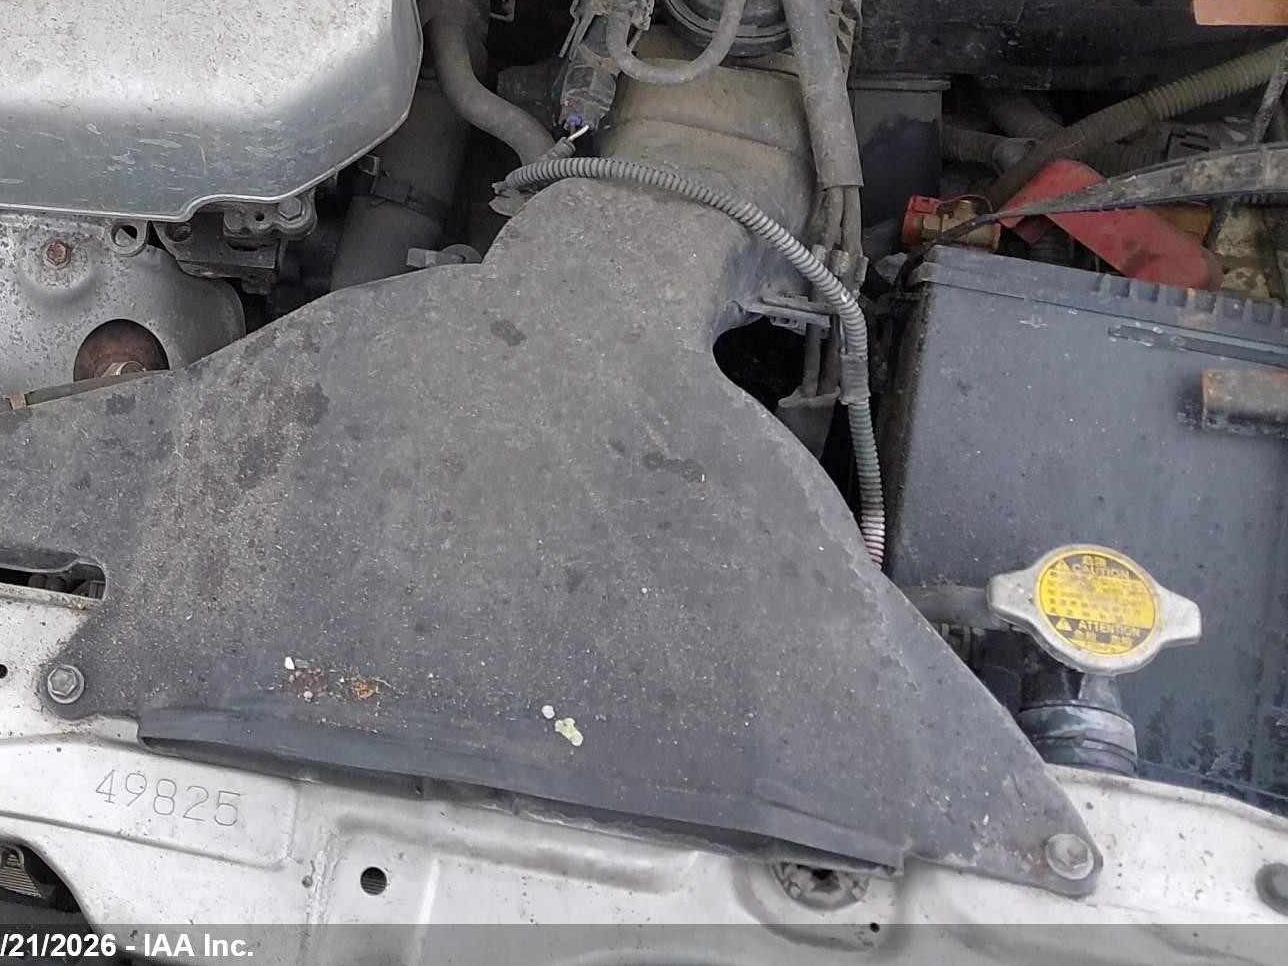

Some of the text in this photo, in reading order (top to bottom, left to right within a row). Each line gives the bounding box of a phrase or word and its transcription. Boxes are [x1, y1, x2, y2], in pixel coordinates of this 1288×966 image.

[1072, 563, 1130, 578] CAUTION
[1078, 619, 1140, 637] ATTENTION
[95, 768, 242, 827] 49825
